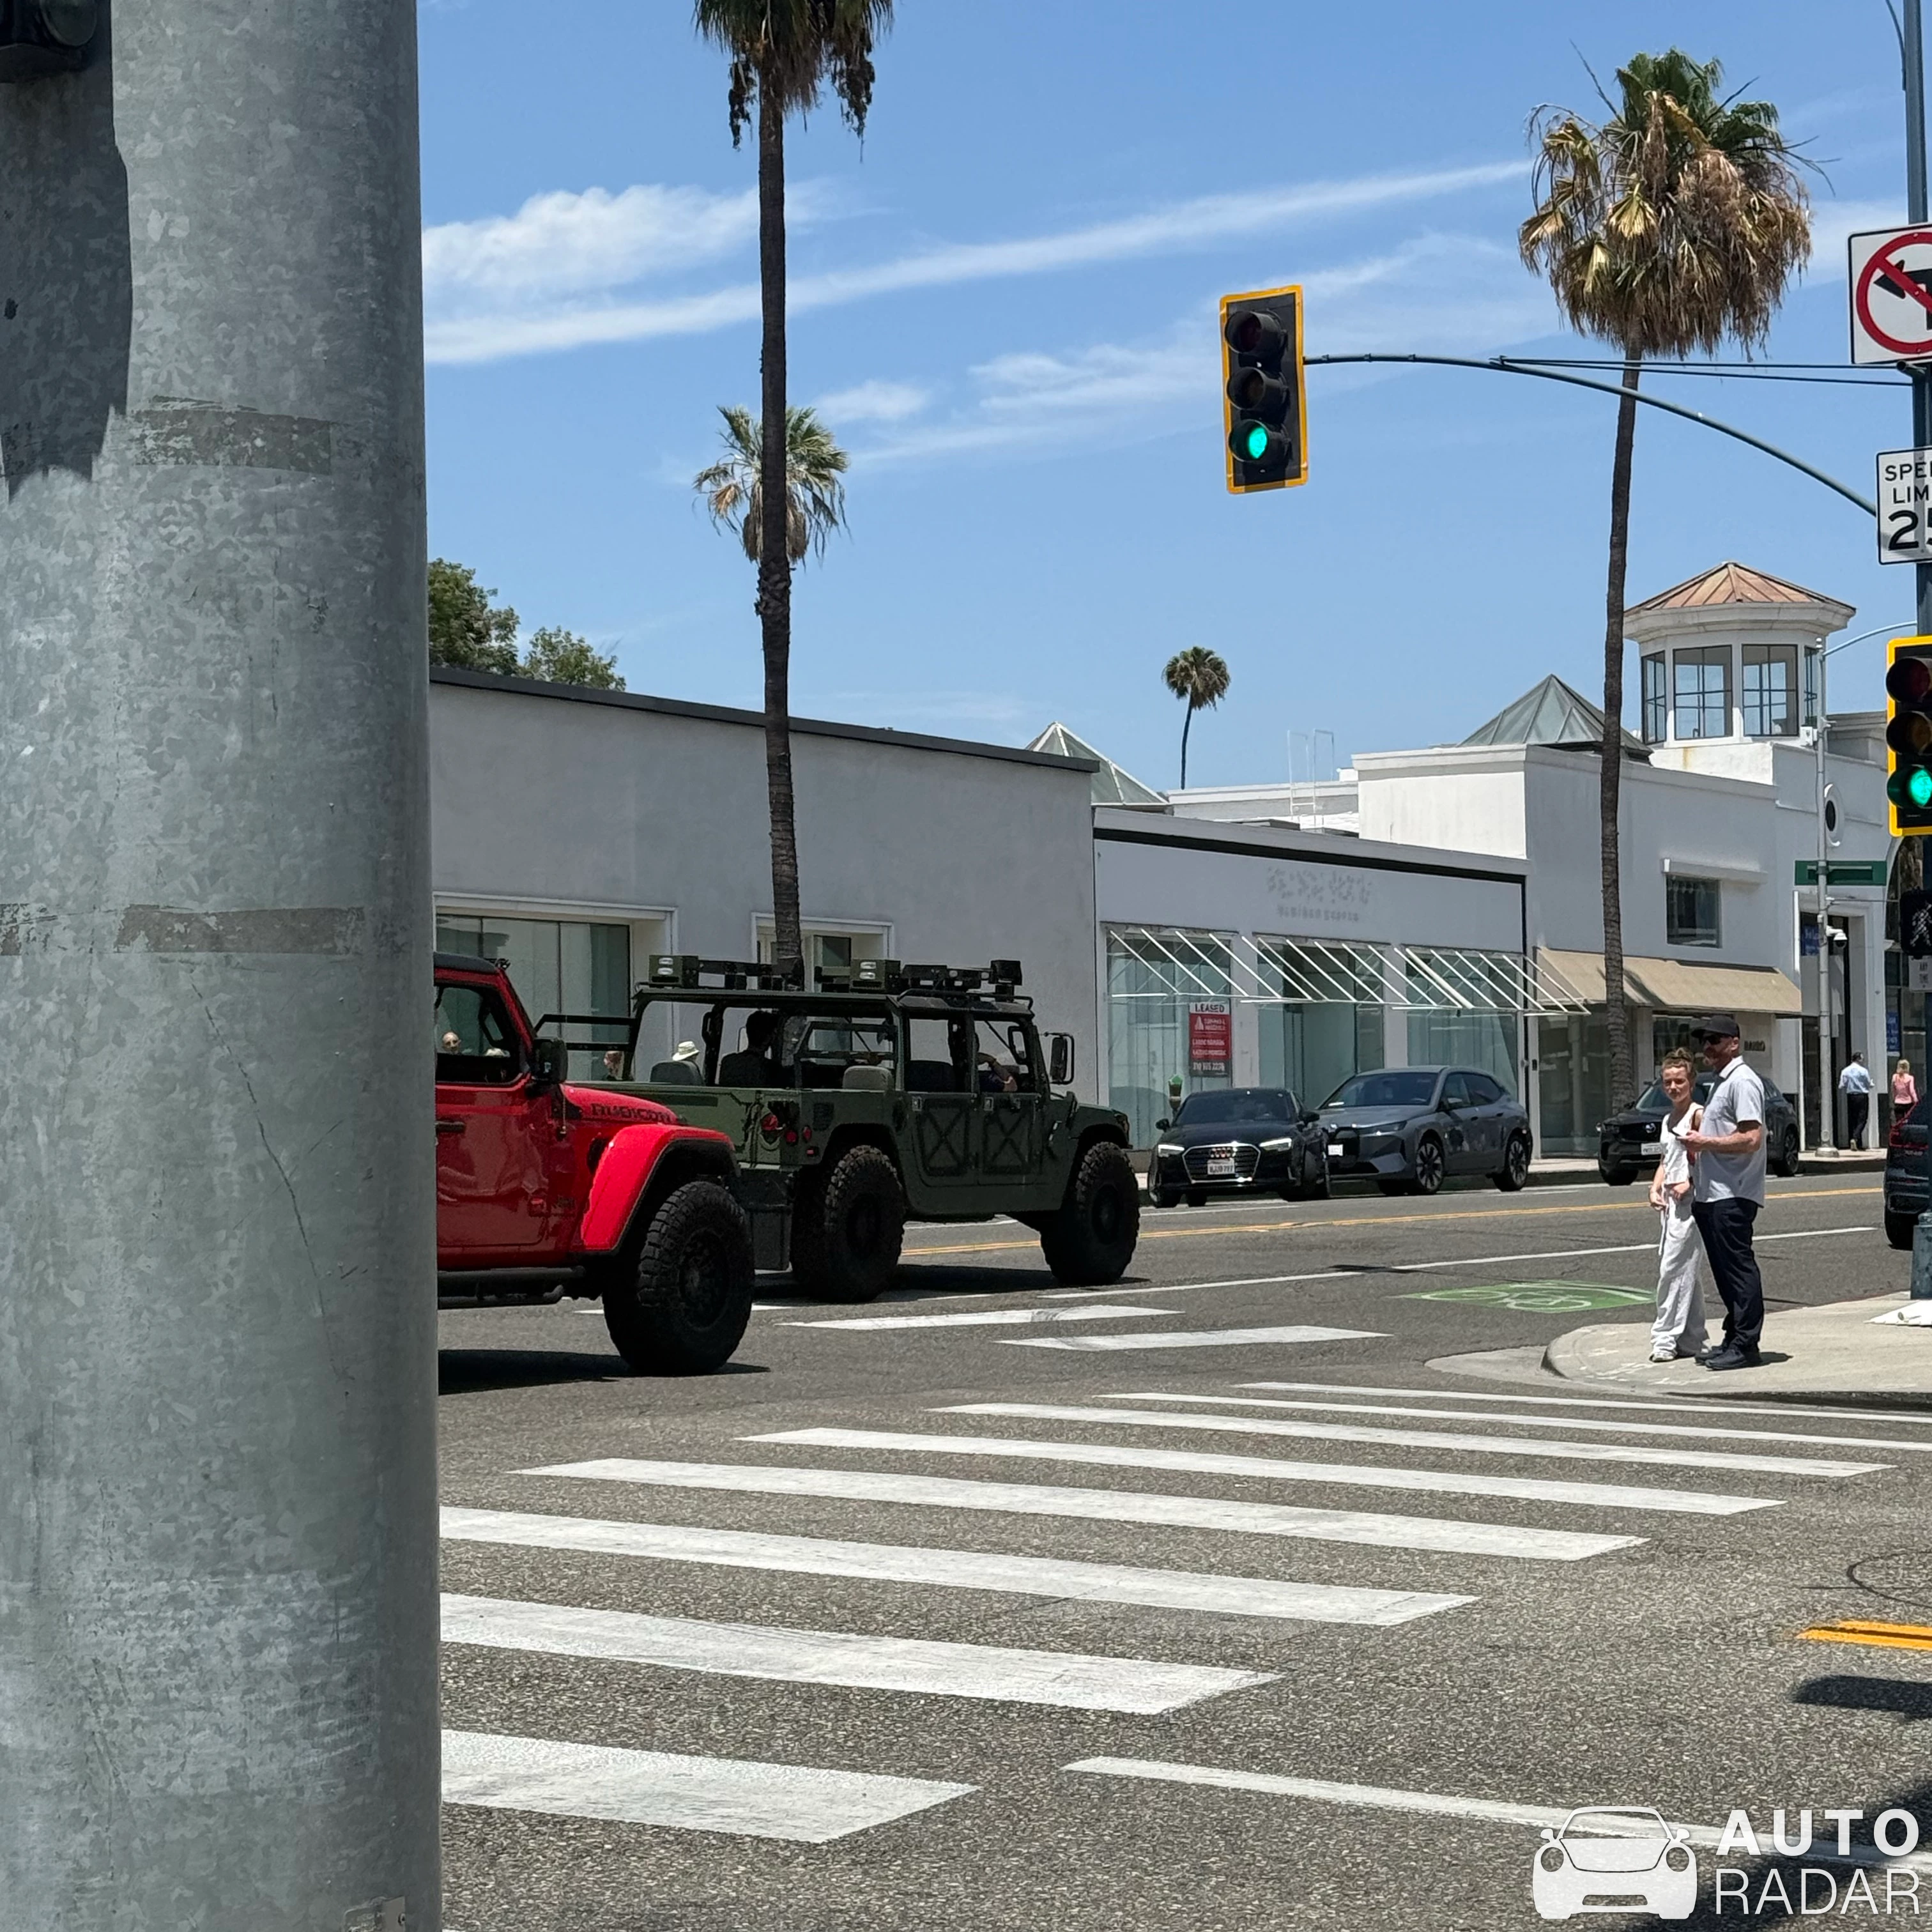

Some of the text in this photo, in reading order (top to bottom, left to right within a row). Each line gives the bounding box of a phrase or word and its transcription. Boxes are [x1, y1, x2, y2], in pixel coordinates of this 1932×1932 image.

[1885, 459, 1932, 481] SPE
[1889, 508, 1932, 551] 2
[1195, 1003, 1225, 1013] LEASED
